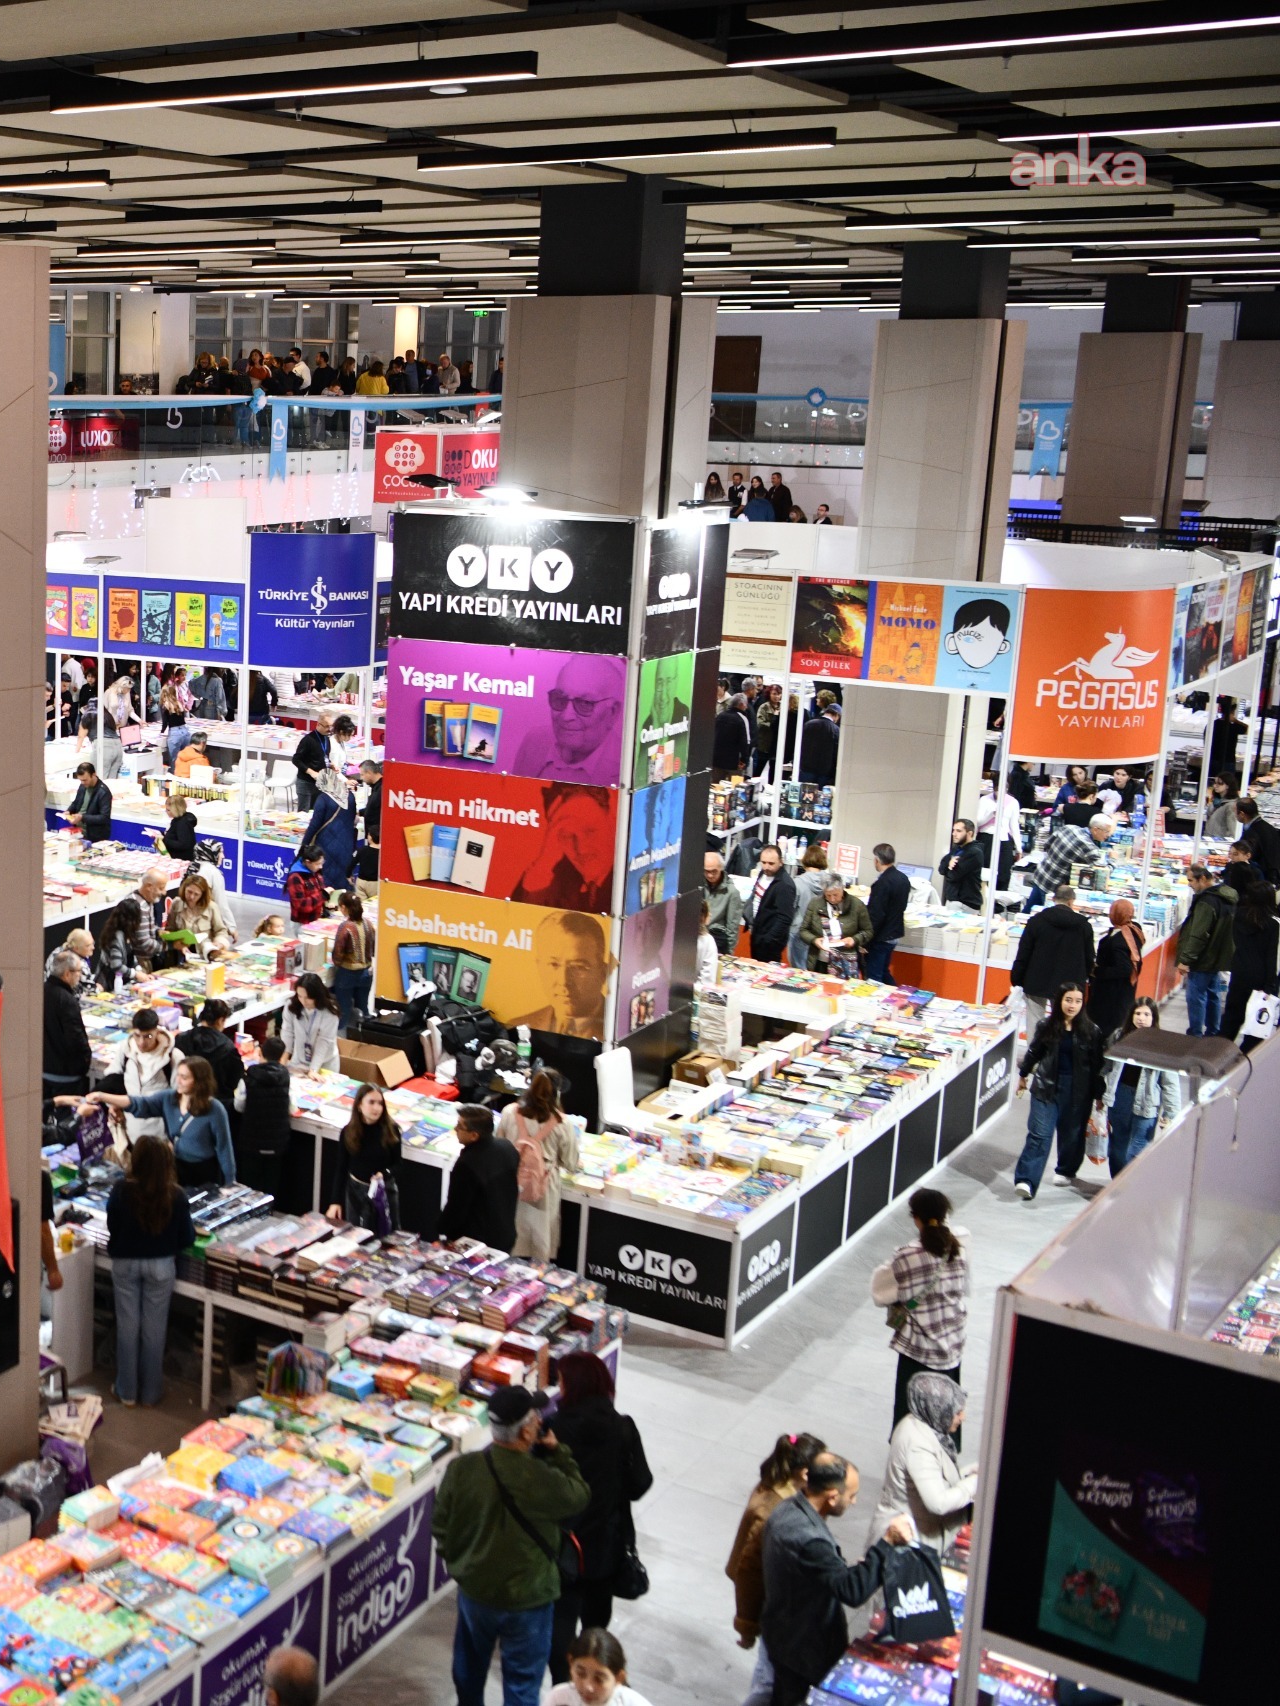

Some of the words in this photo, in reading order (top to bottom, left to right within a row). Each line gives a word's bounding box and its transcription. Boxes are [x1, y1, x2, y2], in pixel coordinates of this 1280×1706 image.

[452, 550, 568, 587] YKY
[258, 589, 309, 601] TÜRKİYE
[329, 590, 368, 601] BANKASI
[398, 592, 441, 613] YAPI
[446, 594, 508, 618] KREDİ
[512, 599, 622, 626] YAYINLARI
[275, 618, 310, 628] Kültür
[312, 619, 354, 630] Yayınları
[879, 616, 936, 630] MOMO
[800, 659, 820, 667] SON
[823, 659, 851, 670] DİLEK
[399, 666, 458, 693] Yaşar
[463, 671, 535, 698] Kemal
[1035, 678, 1159, 711] PEGASUS
[1058, 715, 1145, 729] YAYINLARI
[388, 790, 453, 816] Nâzım
[458, 799, 540, 828] Hikmet
[247, 860, 274, 871] TÜRKİYE
[384, 908, 498, 946] Sabahattin
[503, 929, 533, 951] Ali
[622, 1247, 694, 1281] YKY
[588, 1263, 616, 1281] YAPI
[617, 1271, 657, 1292] KREDİ
[659, 1281, 727, 1310] YAYINLARI
[336, 1567, 412, 1656] indigo
